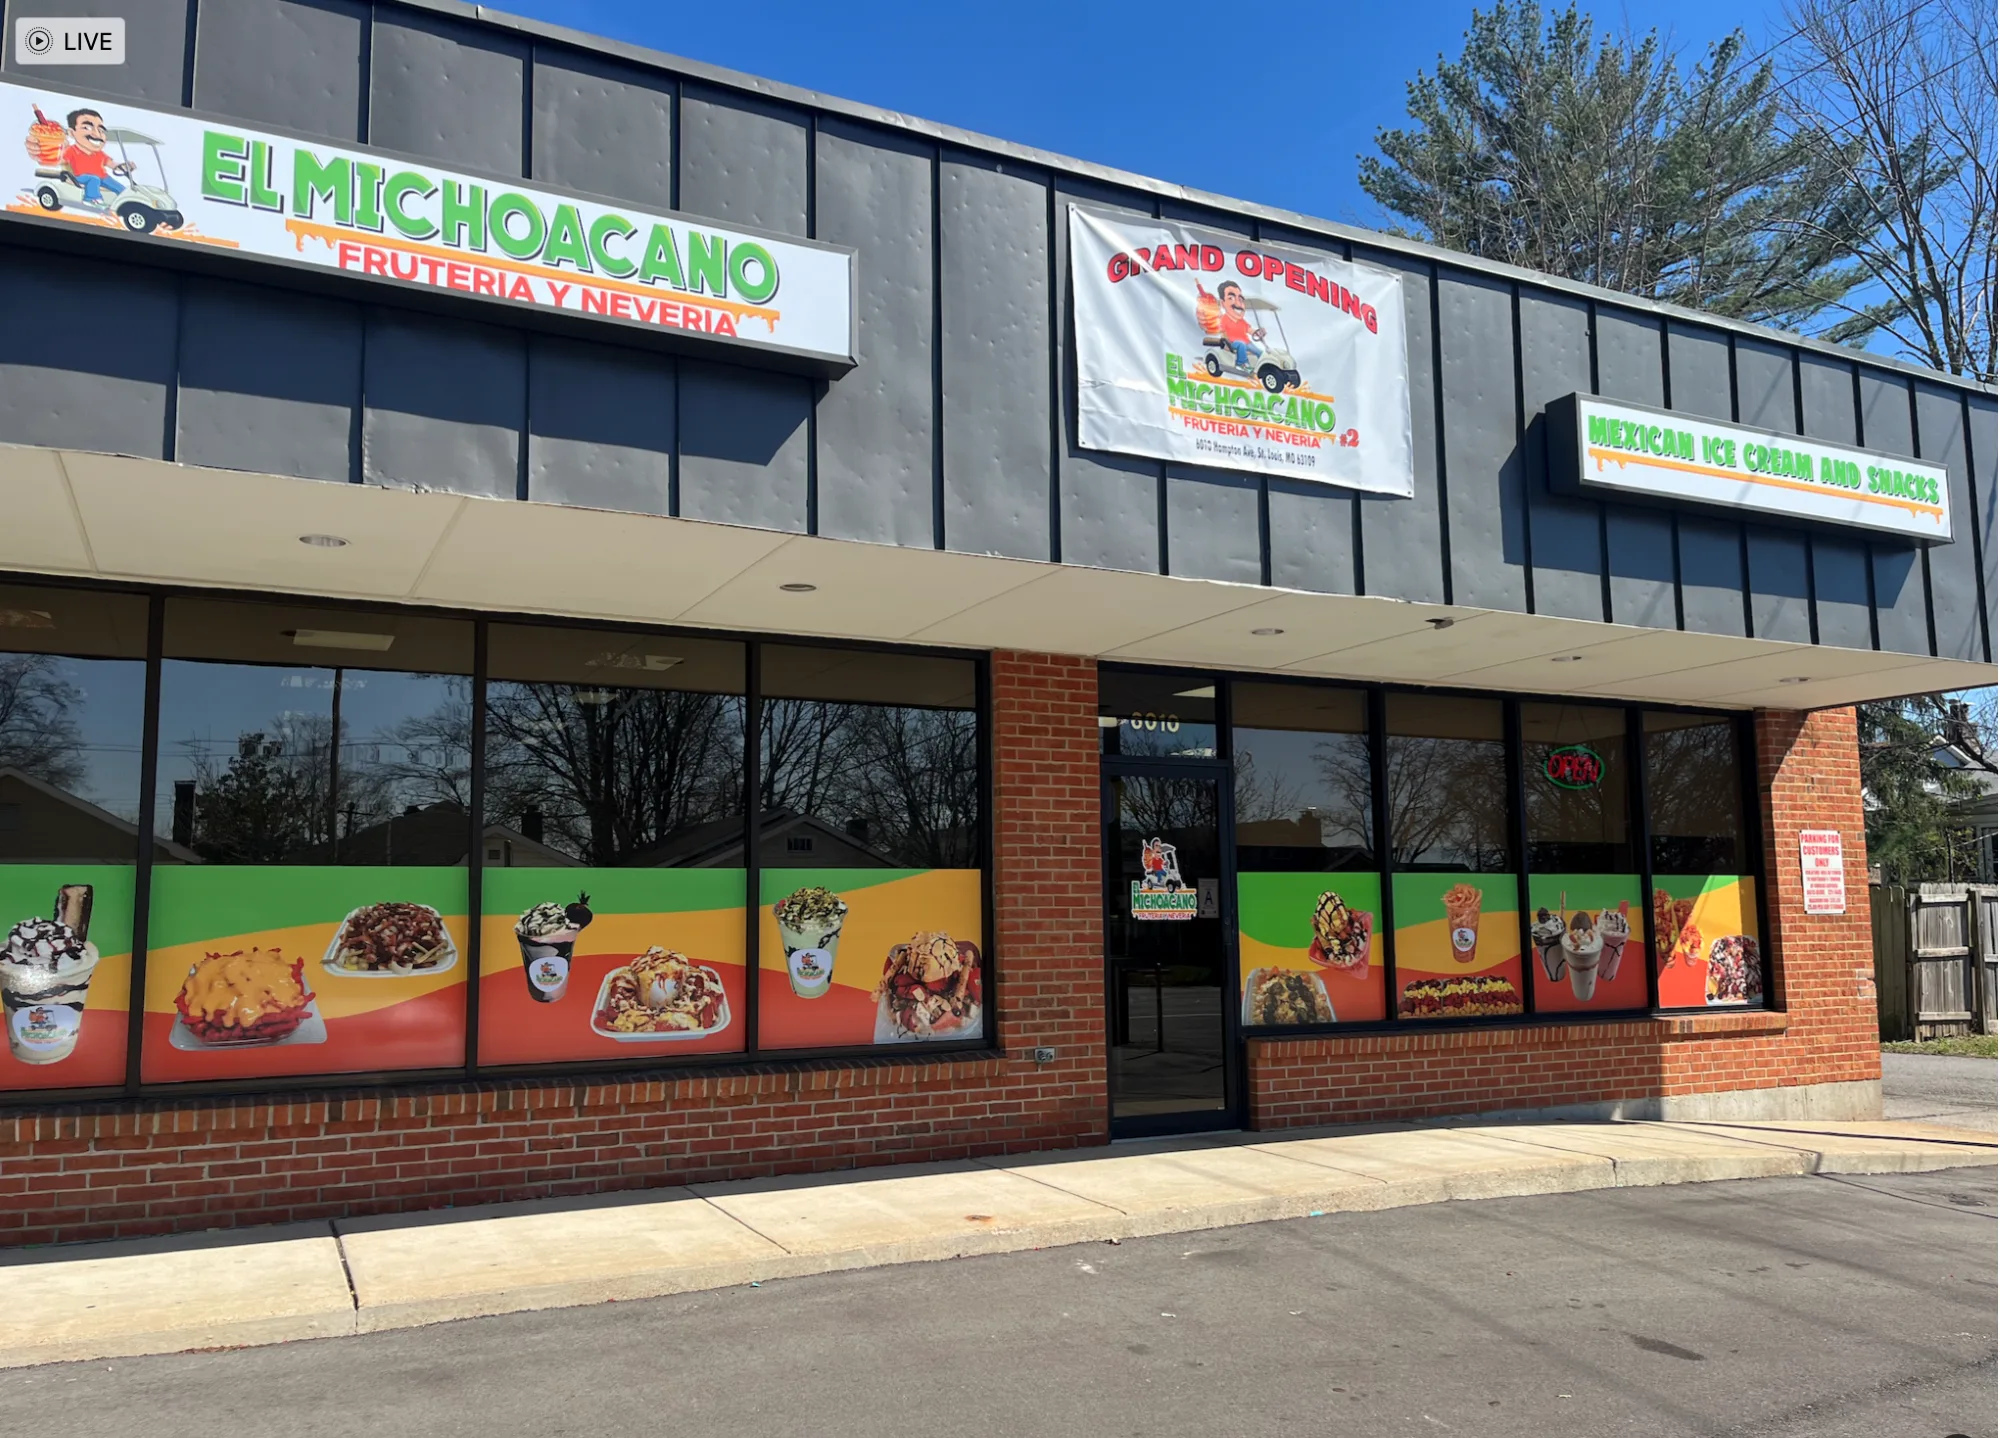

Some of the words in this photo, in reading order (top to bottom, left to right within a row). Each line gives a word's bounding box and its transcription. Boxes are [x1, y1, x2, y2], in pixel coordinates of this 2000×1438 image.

[202, 131, 284, 214] EL
[293, 148, 780, 304] MICHOACANO
[338, 242, 536, 303] FRUTERIA
[546, 281, 572, 307] Y
[581, 287, 738, 337] NEVERIA
[1107, 244, 1224, 283] GRAND
[1235, 250, 1378, 334] OPENING
[1165, 352, 1187, 379] EL
[1166, 376, 1336, 432] MICHOACANO
[1183, 416, 1250, 438] FRUTERIA
[1252, 426, 1262, 439] Y
[1265, 429, 1321, 448] NEVERIA
[1339, 428, 1360, 447] #2
[1195, 438, 1212, 451] 6010
[1213, 440, 1242, 457] Hampton
[1243, 444, 1256, 459] Ave,
[1257, 446, 1266, 459] St.
[1285, 452, 1296, 464] MO
[1297, 454, 1316, 467] 63109
[1588, 415, 1695, 461] MEXICAN
[1702, 435, 1737, 467] ICE
[1743, 442, 1814, 482] CREAM
[1820, 457, 1861, 490] AND
[1867, 465, 1940, 506] SNACKS
[1130, 711, 1180, 733] 6010
[1547, 754, 1600, 783] OPEN
[1800, 833, 1827, 844] PARKING
[1828, 834, 1839, 844] FOR
[1803, 845, 1839, 856] CUSTOMERS
[1133, 893, 1196, 909] MICHOACANO
[1204, 890, 1213, 905] A
